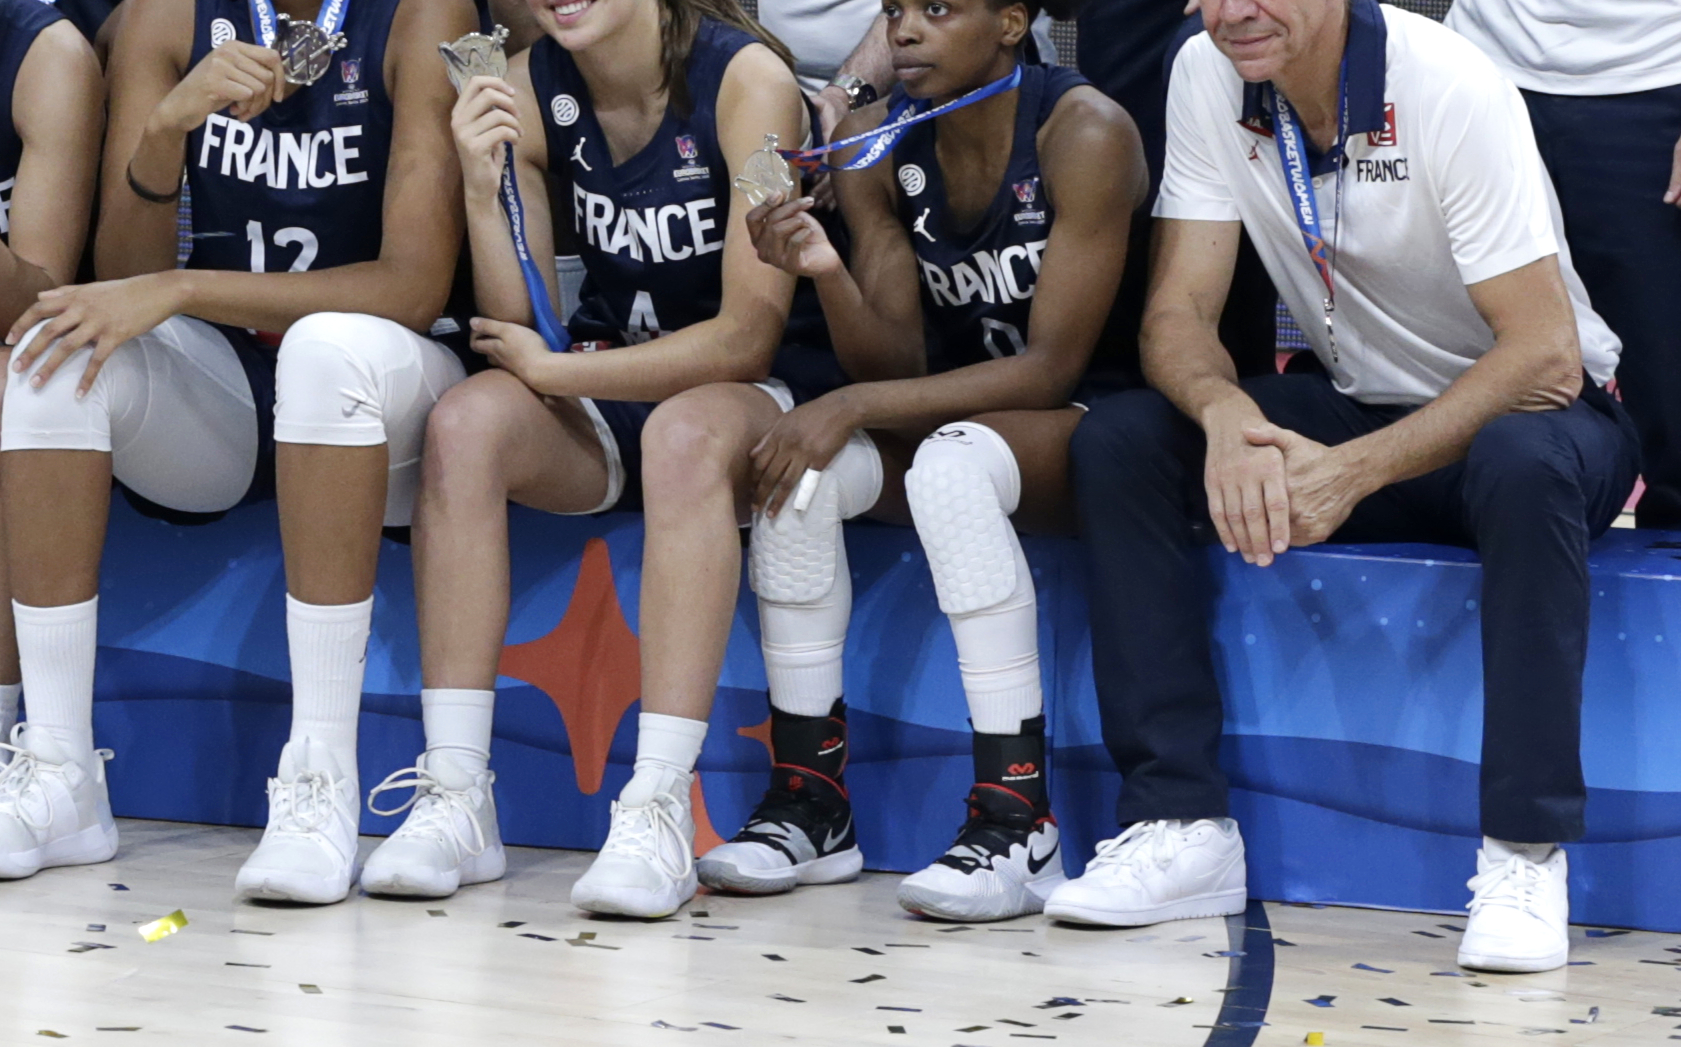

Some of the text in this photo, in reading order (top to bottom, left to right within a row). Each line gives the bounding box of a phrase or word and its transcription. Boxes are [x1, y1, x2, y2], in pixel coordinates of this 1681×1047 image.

[199, 113, 368, 189] FRANCE
[246, 220, 319, 274] 12
[573, 181, 725, 264] FRANCE
